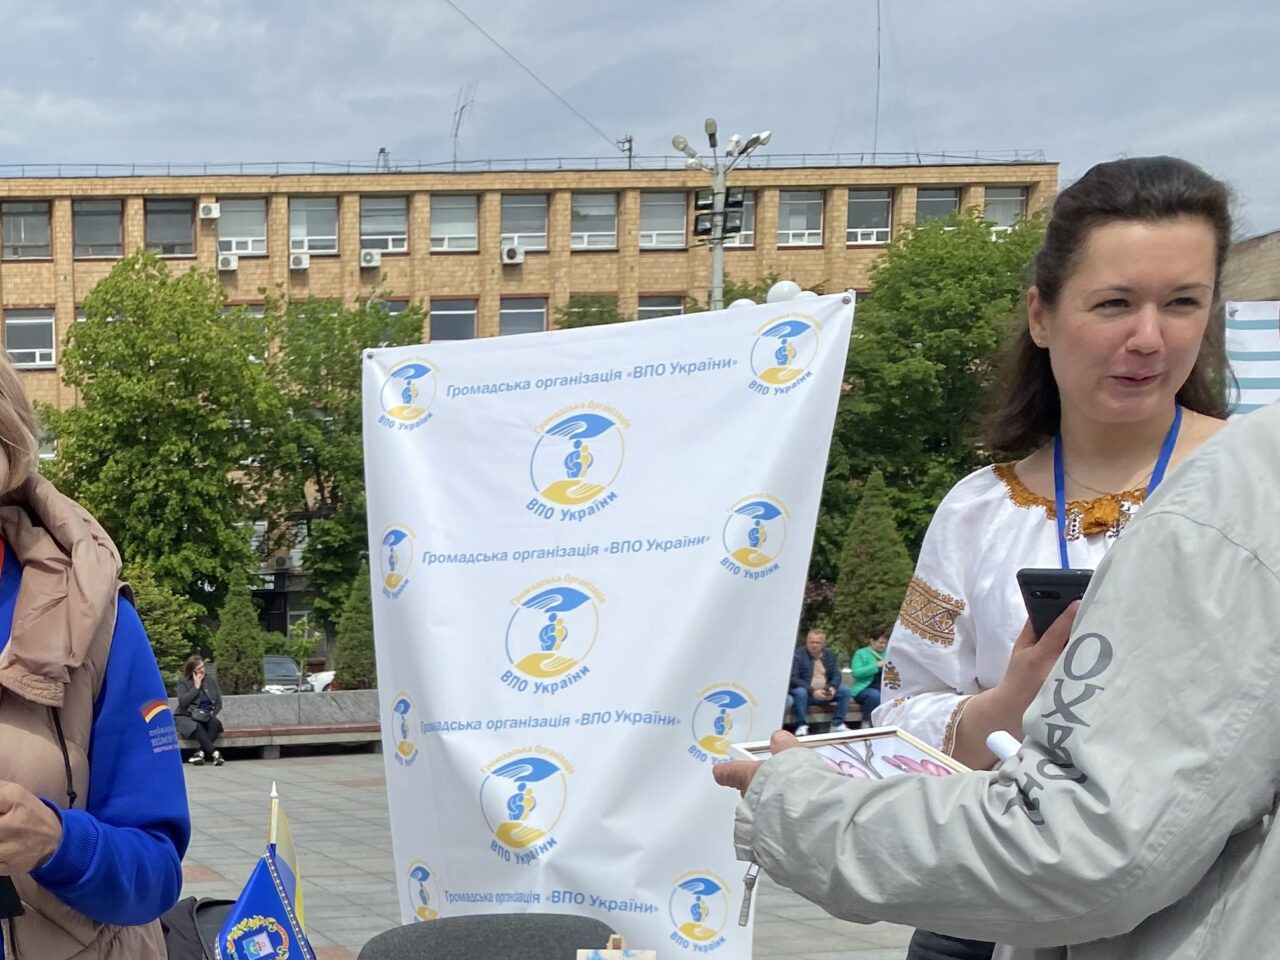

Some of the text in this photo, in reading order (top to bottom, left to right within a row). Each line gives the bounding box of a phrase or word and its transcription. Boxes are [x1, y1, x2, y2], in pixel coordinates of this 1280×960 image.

[446, 380, 530, 399] Громадська
[535, 370, 622, 391] організація
[748, 380, 769, 396] ВПО
[525, 491, 618, 522] ВПО України
[421, 550, 508, 565] Громадська
[513, 543, 599, 562] організація
[720, 556, 740, 575] ВПО
[500, 664, 591, 695] ВПО України
[486, 716, 570, 731] організація
[688, 745, 708, 762] ВПО
[490, 839, 511, 862] ВПО
[669, 930, 689, 949] ВПО
